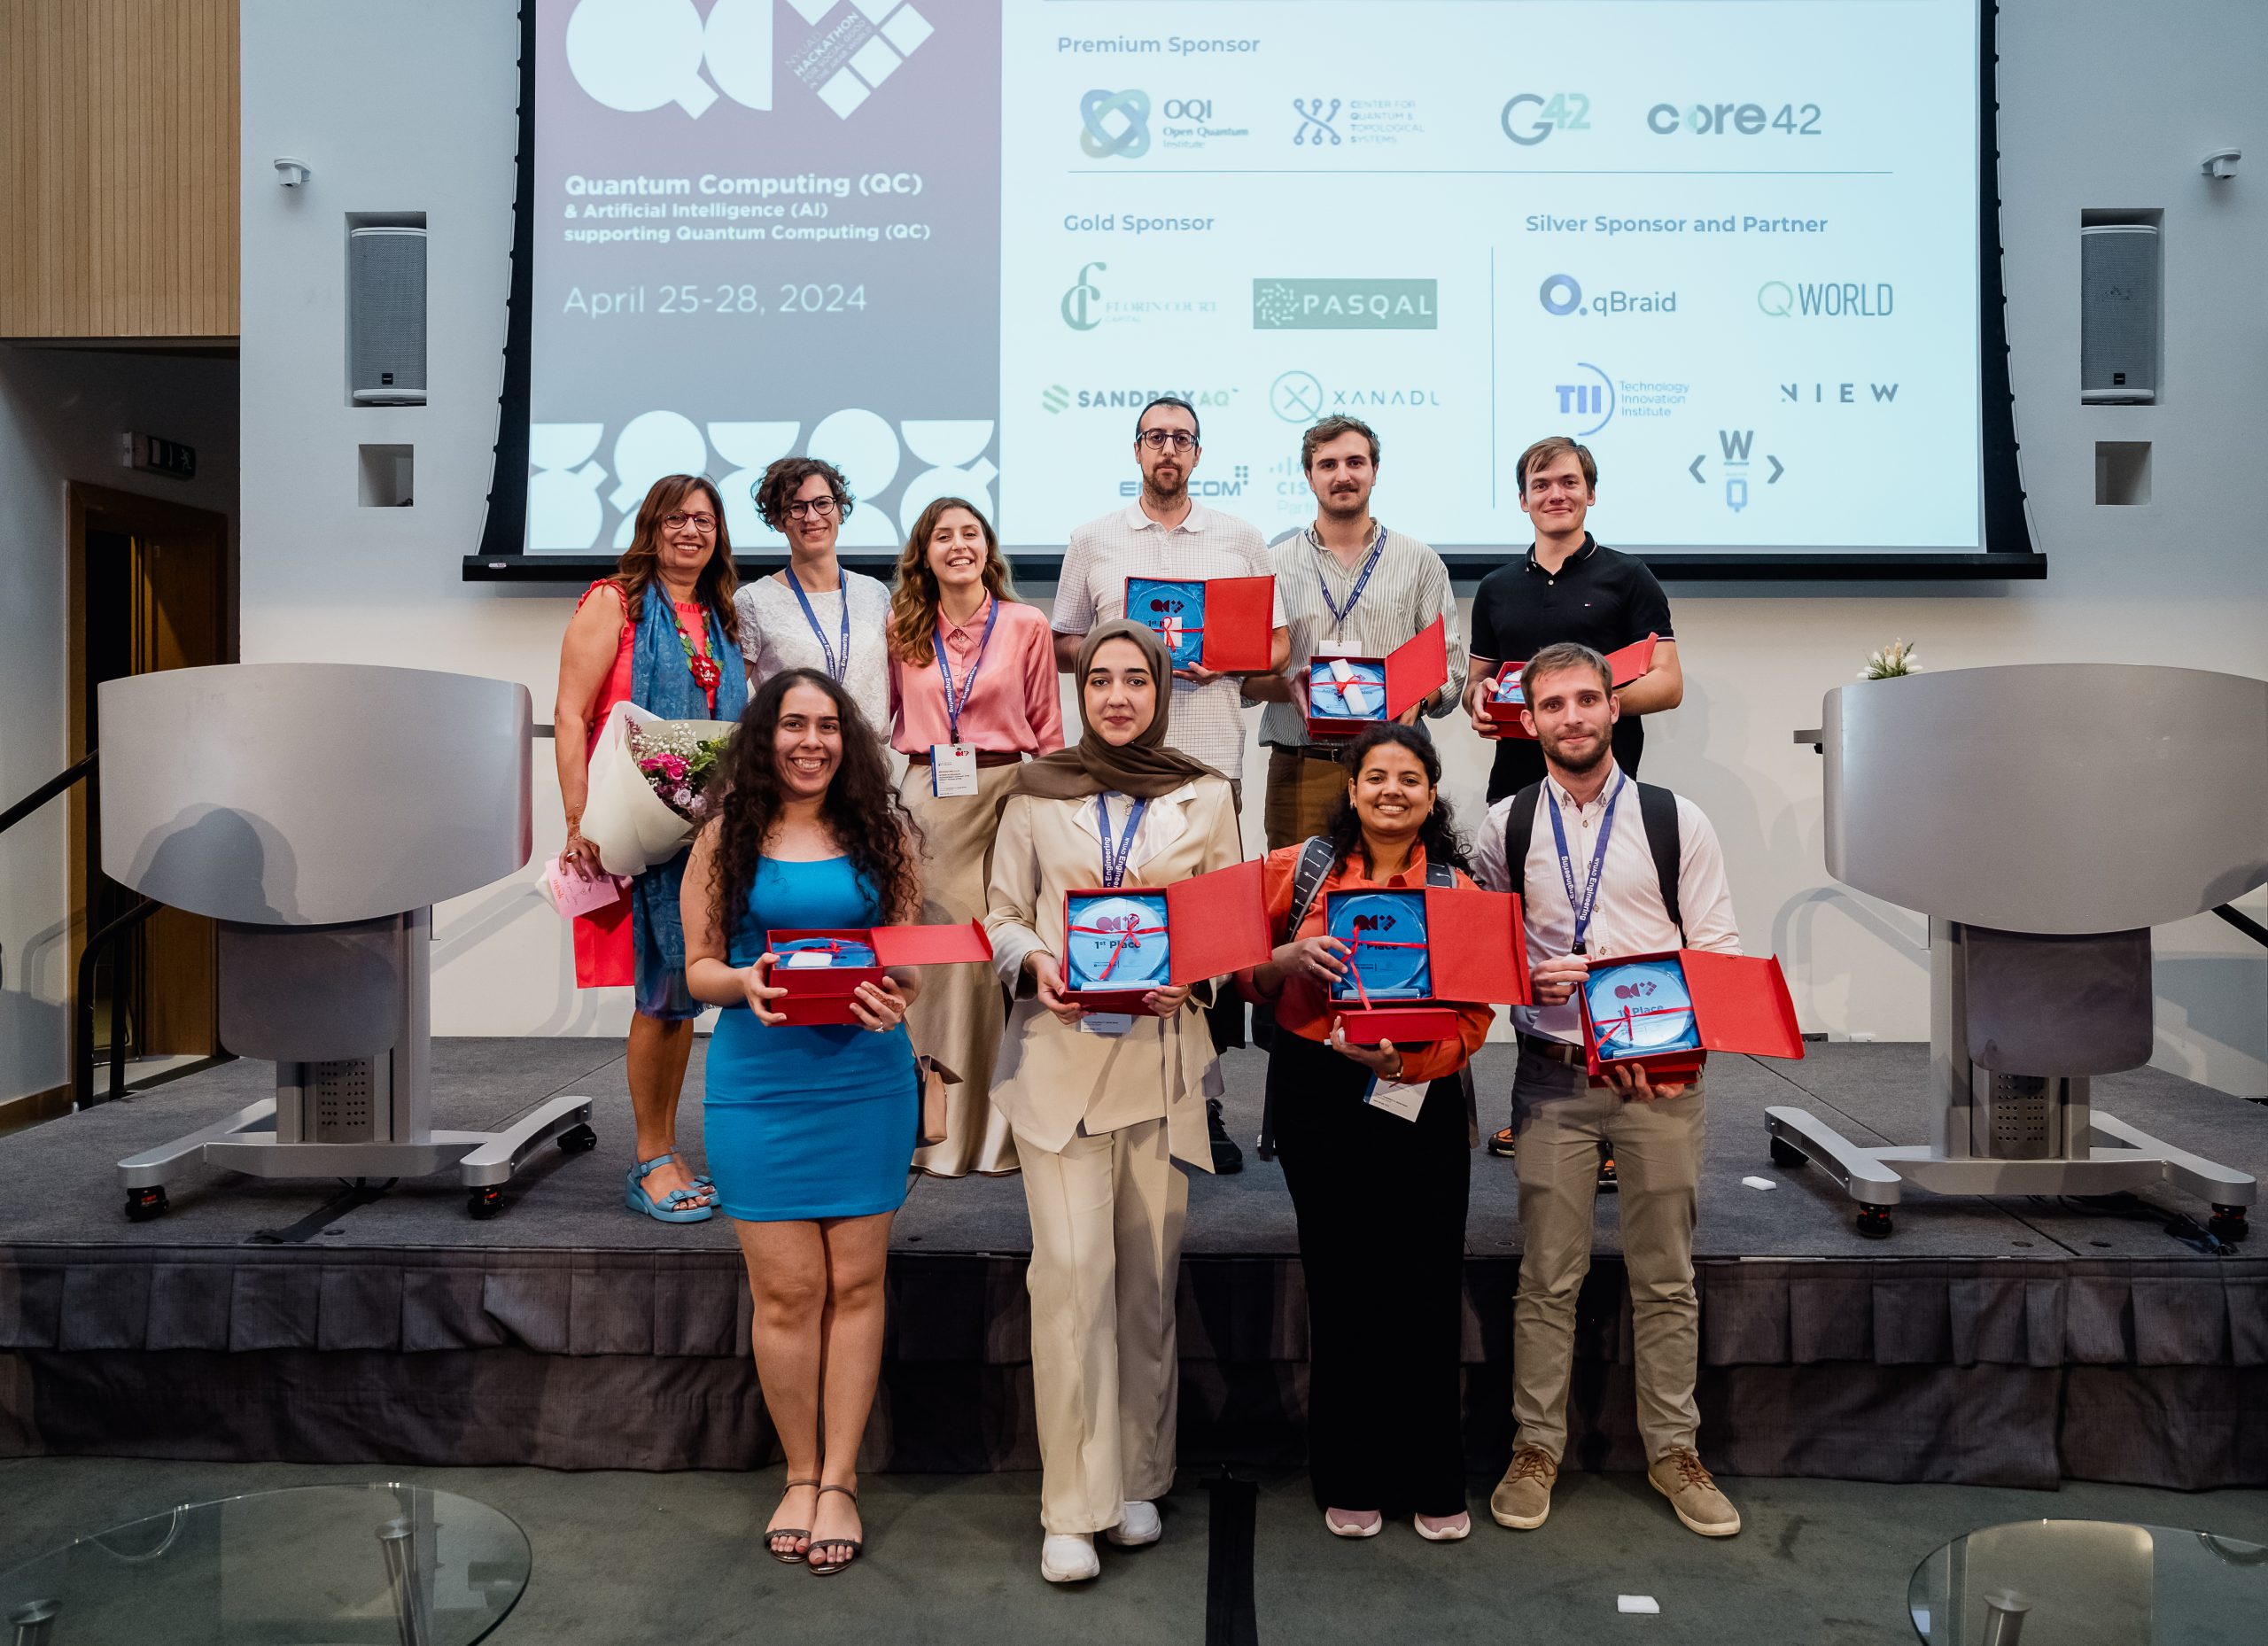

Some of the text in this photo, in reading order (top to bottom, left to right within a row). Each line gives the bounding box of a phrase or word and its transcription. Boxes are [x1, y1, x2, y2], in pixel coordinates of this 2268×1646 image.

[792, 11, 859, 78] HACKATHON
[1059, 35, 1261, 57] Premium Sponsor
[1163, 98, 1212, 123] OQI
[1350, 112, 1404, 120] QUANTUM
[1501, 93, 1591, 146] G42
[1162, 127, 1249, 138] Open Quantum
[1350, 124, 1425, 133] TOPOLOGICAL
[1163, 140, 1205, 149] Institute
[565, 173, 923, 198] Quantum Computing (QC)
[564, 202, 828, 221] & Artificial Intelligence (AI)
[564, 223, 931, 245] supporting Quantum Computing (QC)
[1064, 214, 1216, 236] Gold Sponsor
[1526, 214, 1829, 236] Silver Sponsor and Partner
[563, 283, 867, 319] April 25-28, 2024
[1164, 301, 1217, 313] COURT
[1302, 294, 1433, 320] PASQAL
[1592, 291, 1677, 317] qBraid
[1619, 380, 1690, 395] Technology
[1556, 385, 1602, 415] TII
[1620, 393, 1686, 405] Innovation
[1620, 406, 1672, 417] Institute
[962, 665, 977, 702] Engineering
[945, 677, 954, 713] Engineering
[1104, 837, 1114, 881] Engineering
[1579, 877, 1597, 921] Engineering
